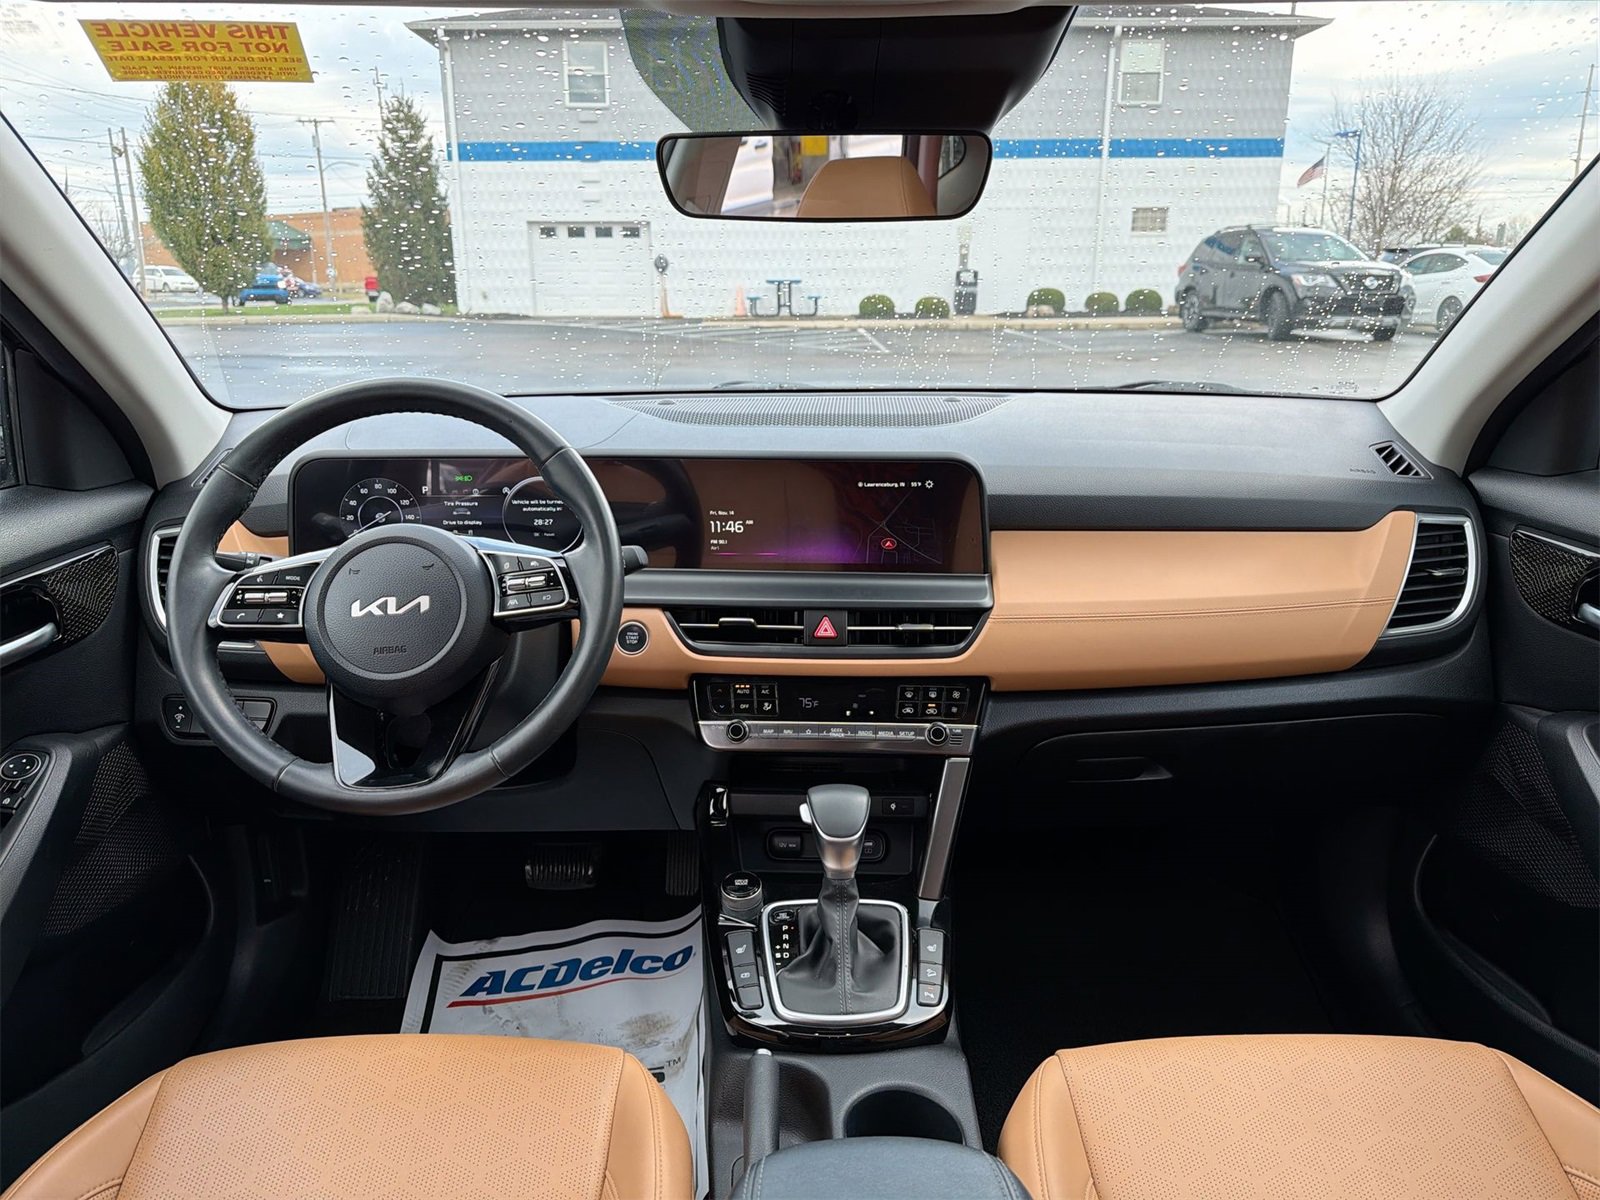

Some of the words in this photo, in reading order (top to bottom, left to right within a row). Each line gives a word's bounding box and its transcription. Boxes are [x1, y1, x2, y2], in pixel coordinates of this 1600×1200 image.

[422, 486, 429, 494] P
[533, 518, 554, 526] 28:27
[710, 520, 744, 533] 11:46
[350, 595, 430, 618] KIA
[373, 645, 407, 655] AIRBAG
[459, 945, 694, 997] ACDelco
